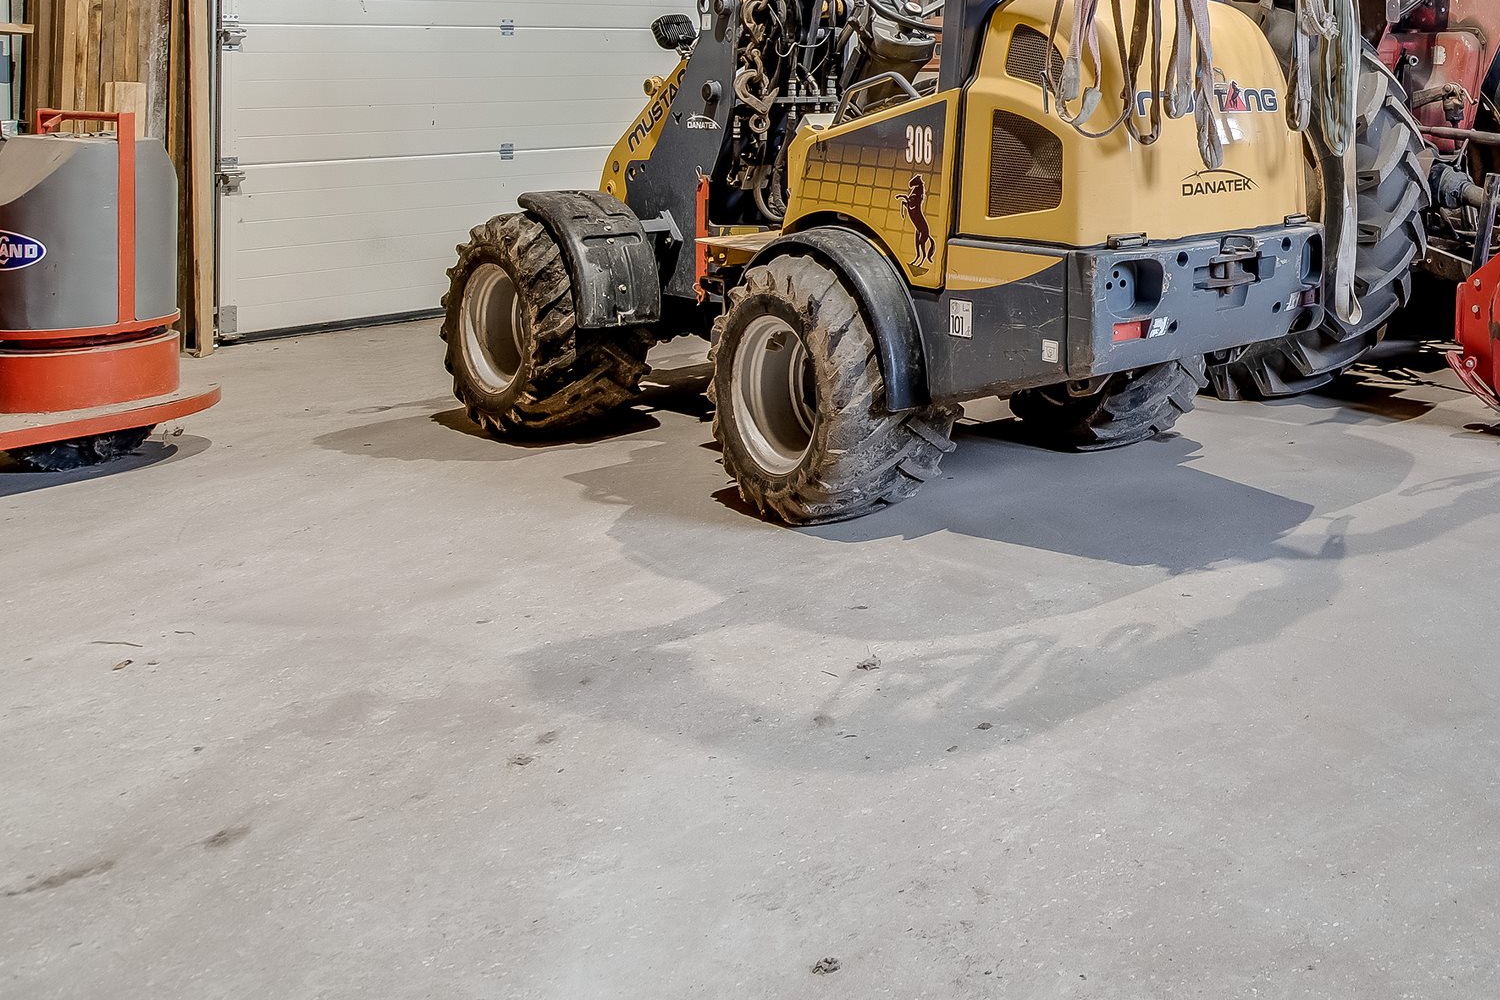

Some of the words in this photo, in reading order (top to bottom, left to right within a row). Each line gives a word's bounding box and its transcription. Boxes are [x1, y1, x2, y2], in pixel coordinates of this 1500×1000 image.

[687, 120, 718, 130] DANATEK
[905, 124, 933, 165] 306
[1182, 178, 1252, 197] DANATEK
[950, 315, 964, 335] 101
